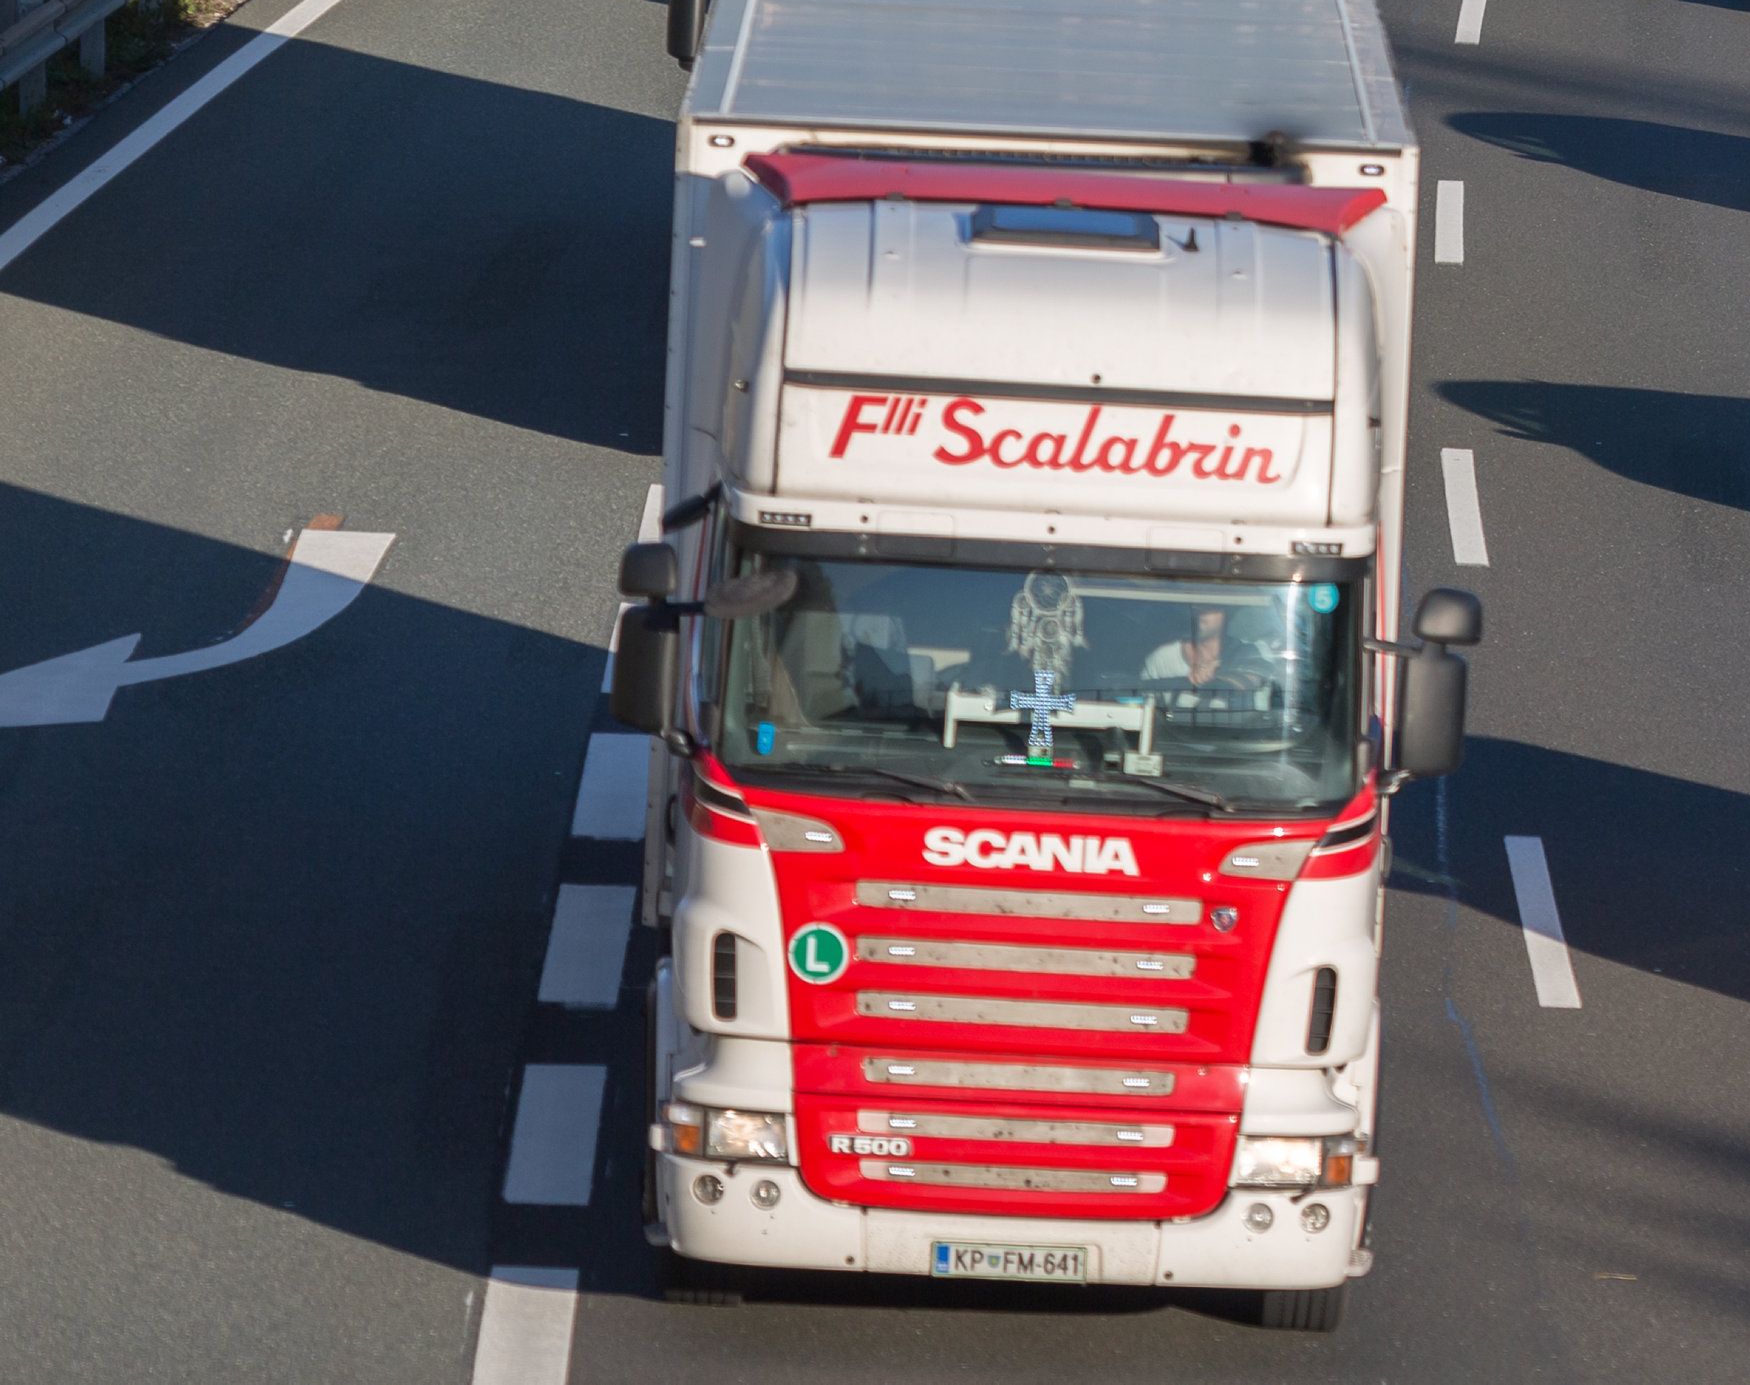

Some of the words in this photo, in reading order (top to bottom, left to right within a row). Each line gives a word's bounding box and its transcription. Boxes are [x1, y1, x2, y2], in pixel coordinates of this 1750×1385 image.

[932, 396, 1281, 485] Scalabrin
[921, 825, 1141, 877] SCANIA
[806, 935, 830, 972] L
[955, 1249, 984, 1272] KP
[1003, 1251, 1079, 1276] FM-641
